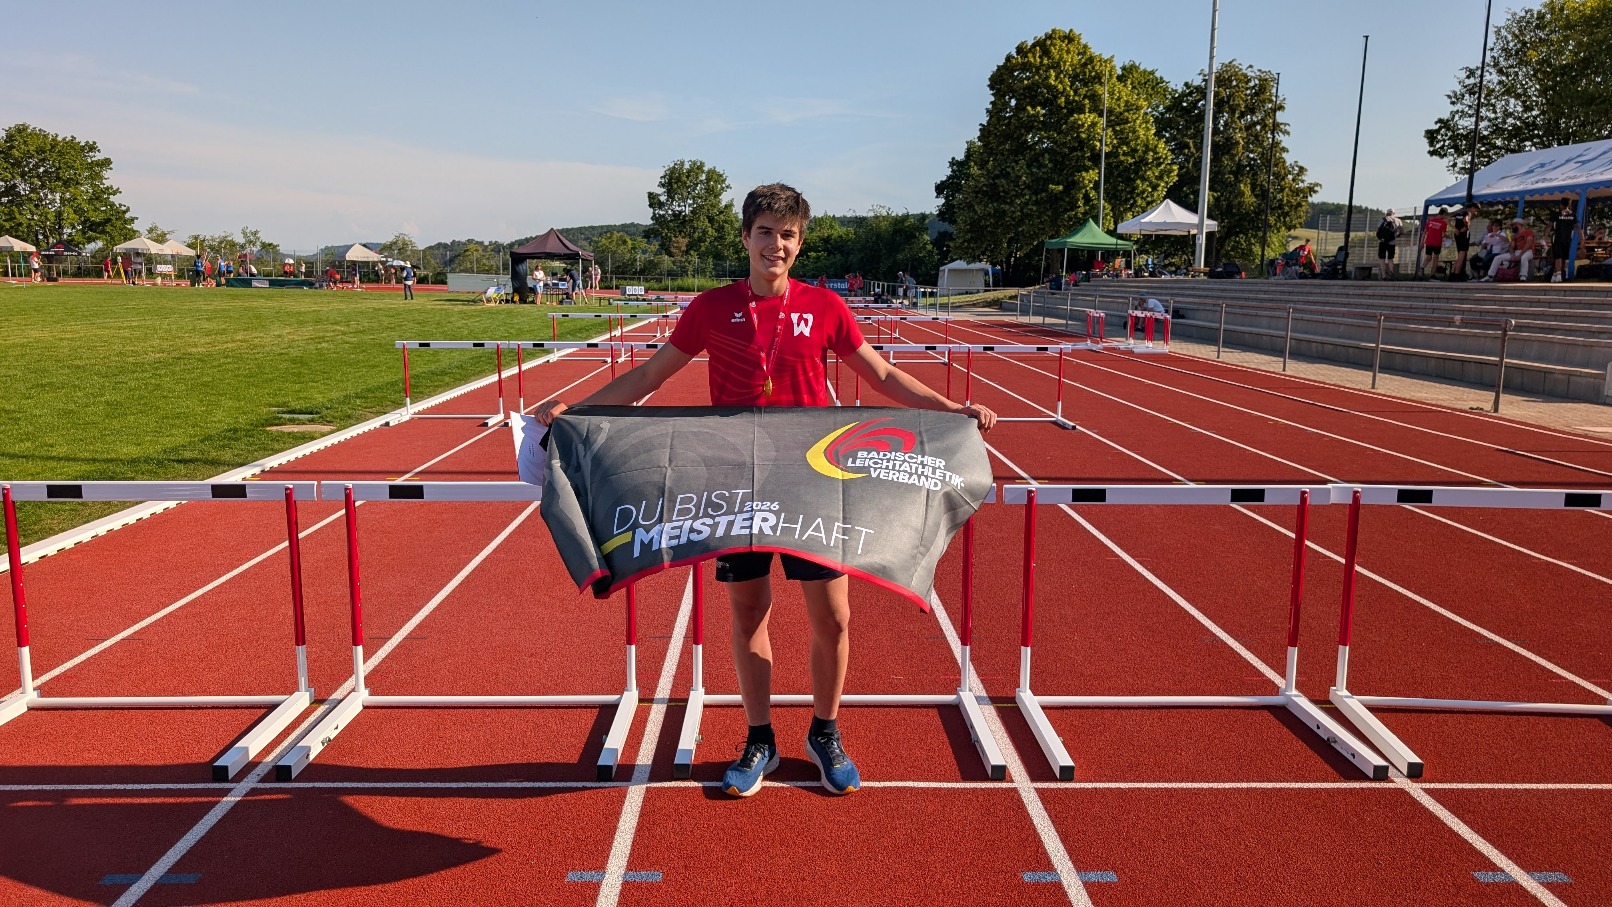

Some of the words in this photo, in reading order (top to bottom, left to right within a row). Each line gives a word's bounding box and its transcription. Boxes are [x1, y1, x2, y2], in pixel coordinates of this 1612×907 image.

[790, 312, 814, 337] W
[857, 451, 946, 469] BADISCHER
[847, 457, 965, 490] LEICHTATHLETIK-
[869, 467, 942, 491] VERBAND
[613, 497, 664, 535] DU
[672, 489, 752, 521] BIST
[743, 501, 780, 512] 2026
